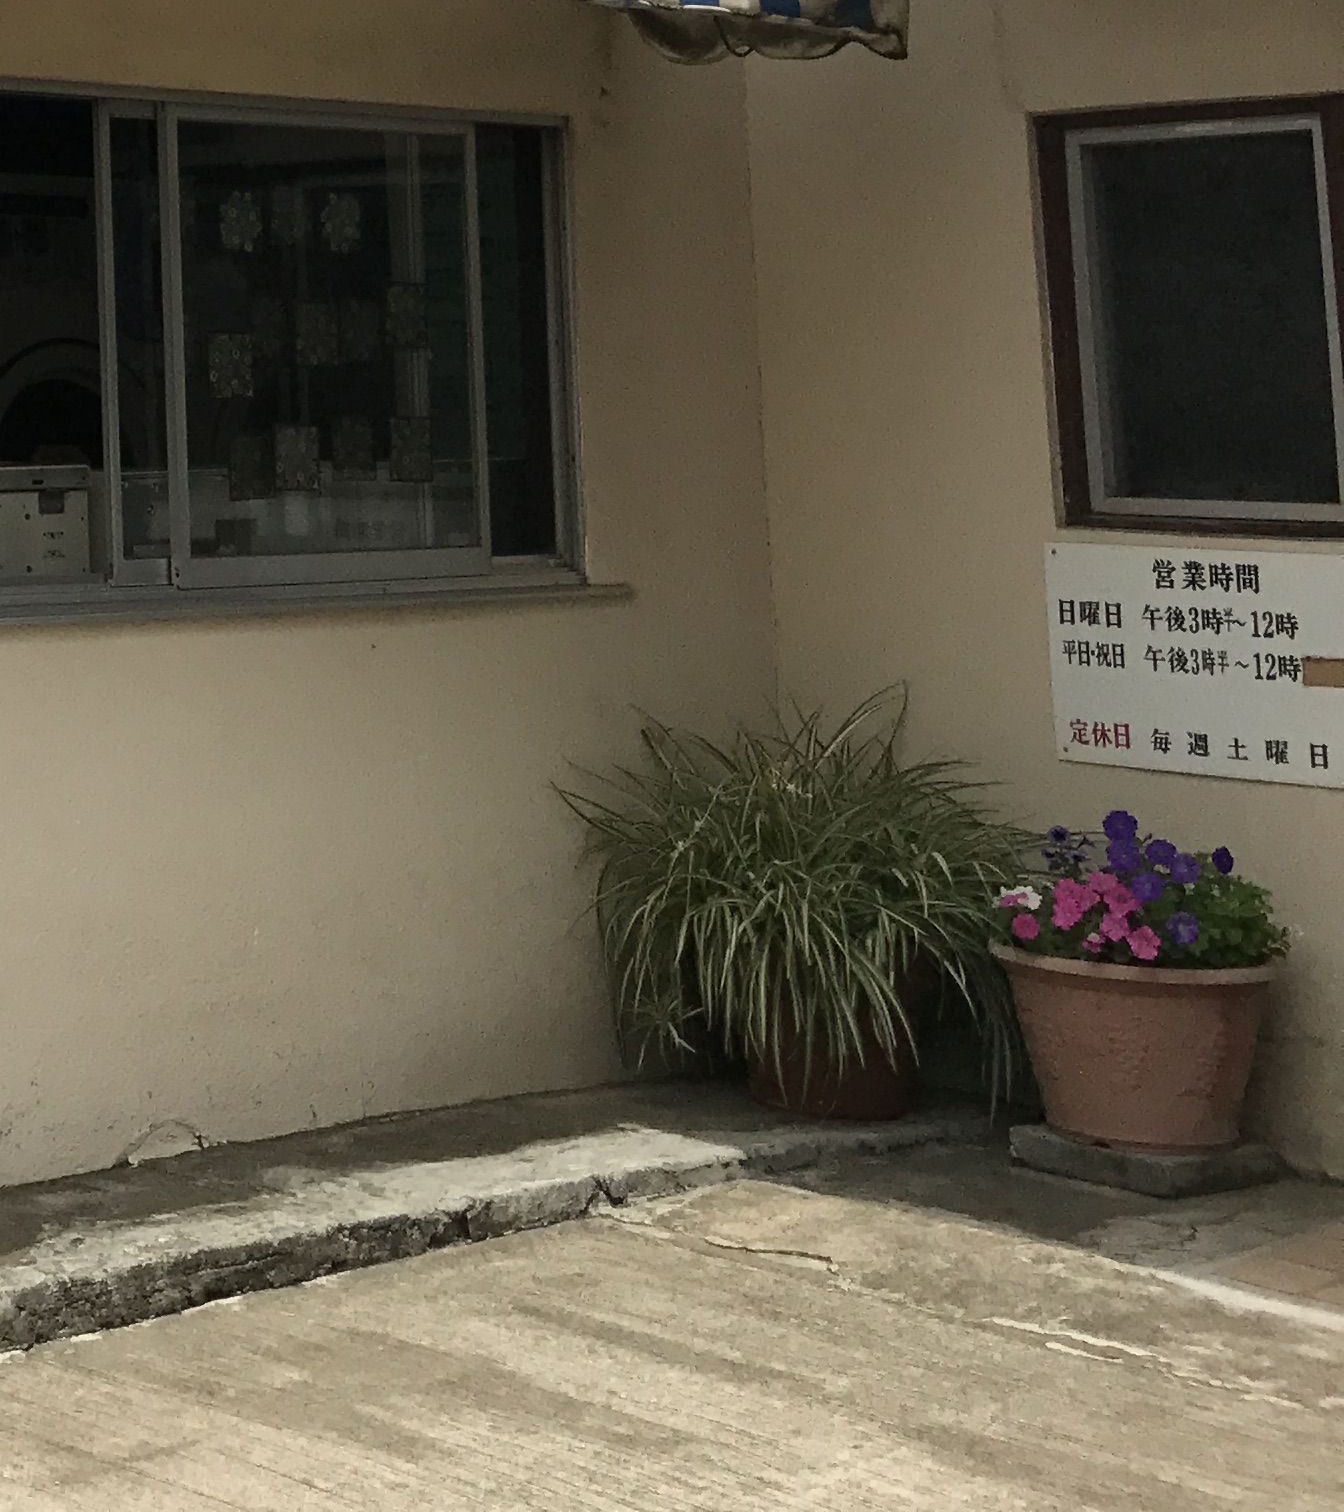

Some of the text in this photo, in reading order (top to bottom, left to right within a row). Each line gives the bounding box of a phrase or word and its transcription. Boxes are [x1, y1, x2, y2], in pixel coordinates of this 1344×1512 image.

[1151, 559, 1261, 595] 営業時間
[1058, 598, 1123, 629] 日曜日
[1069, 718, 1330, 771] 定休日 毎週土曜日
